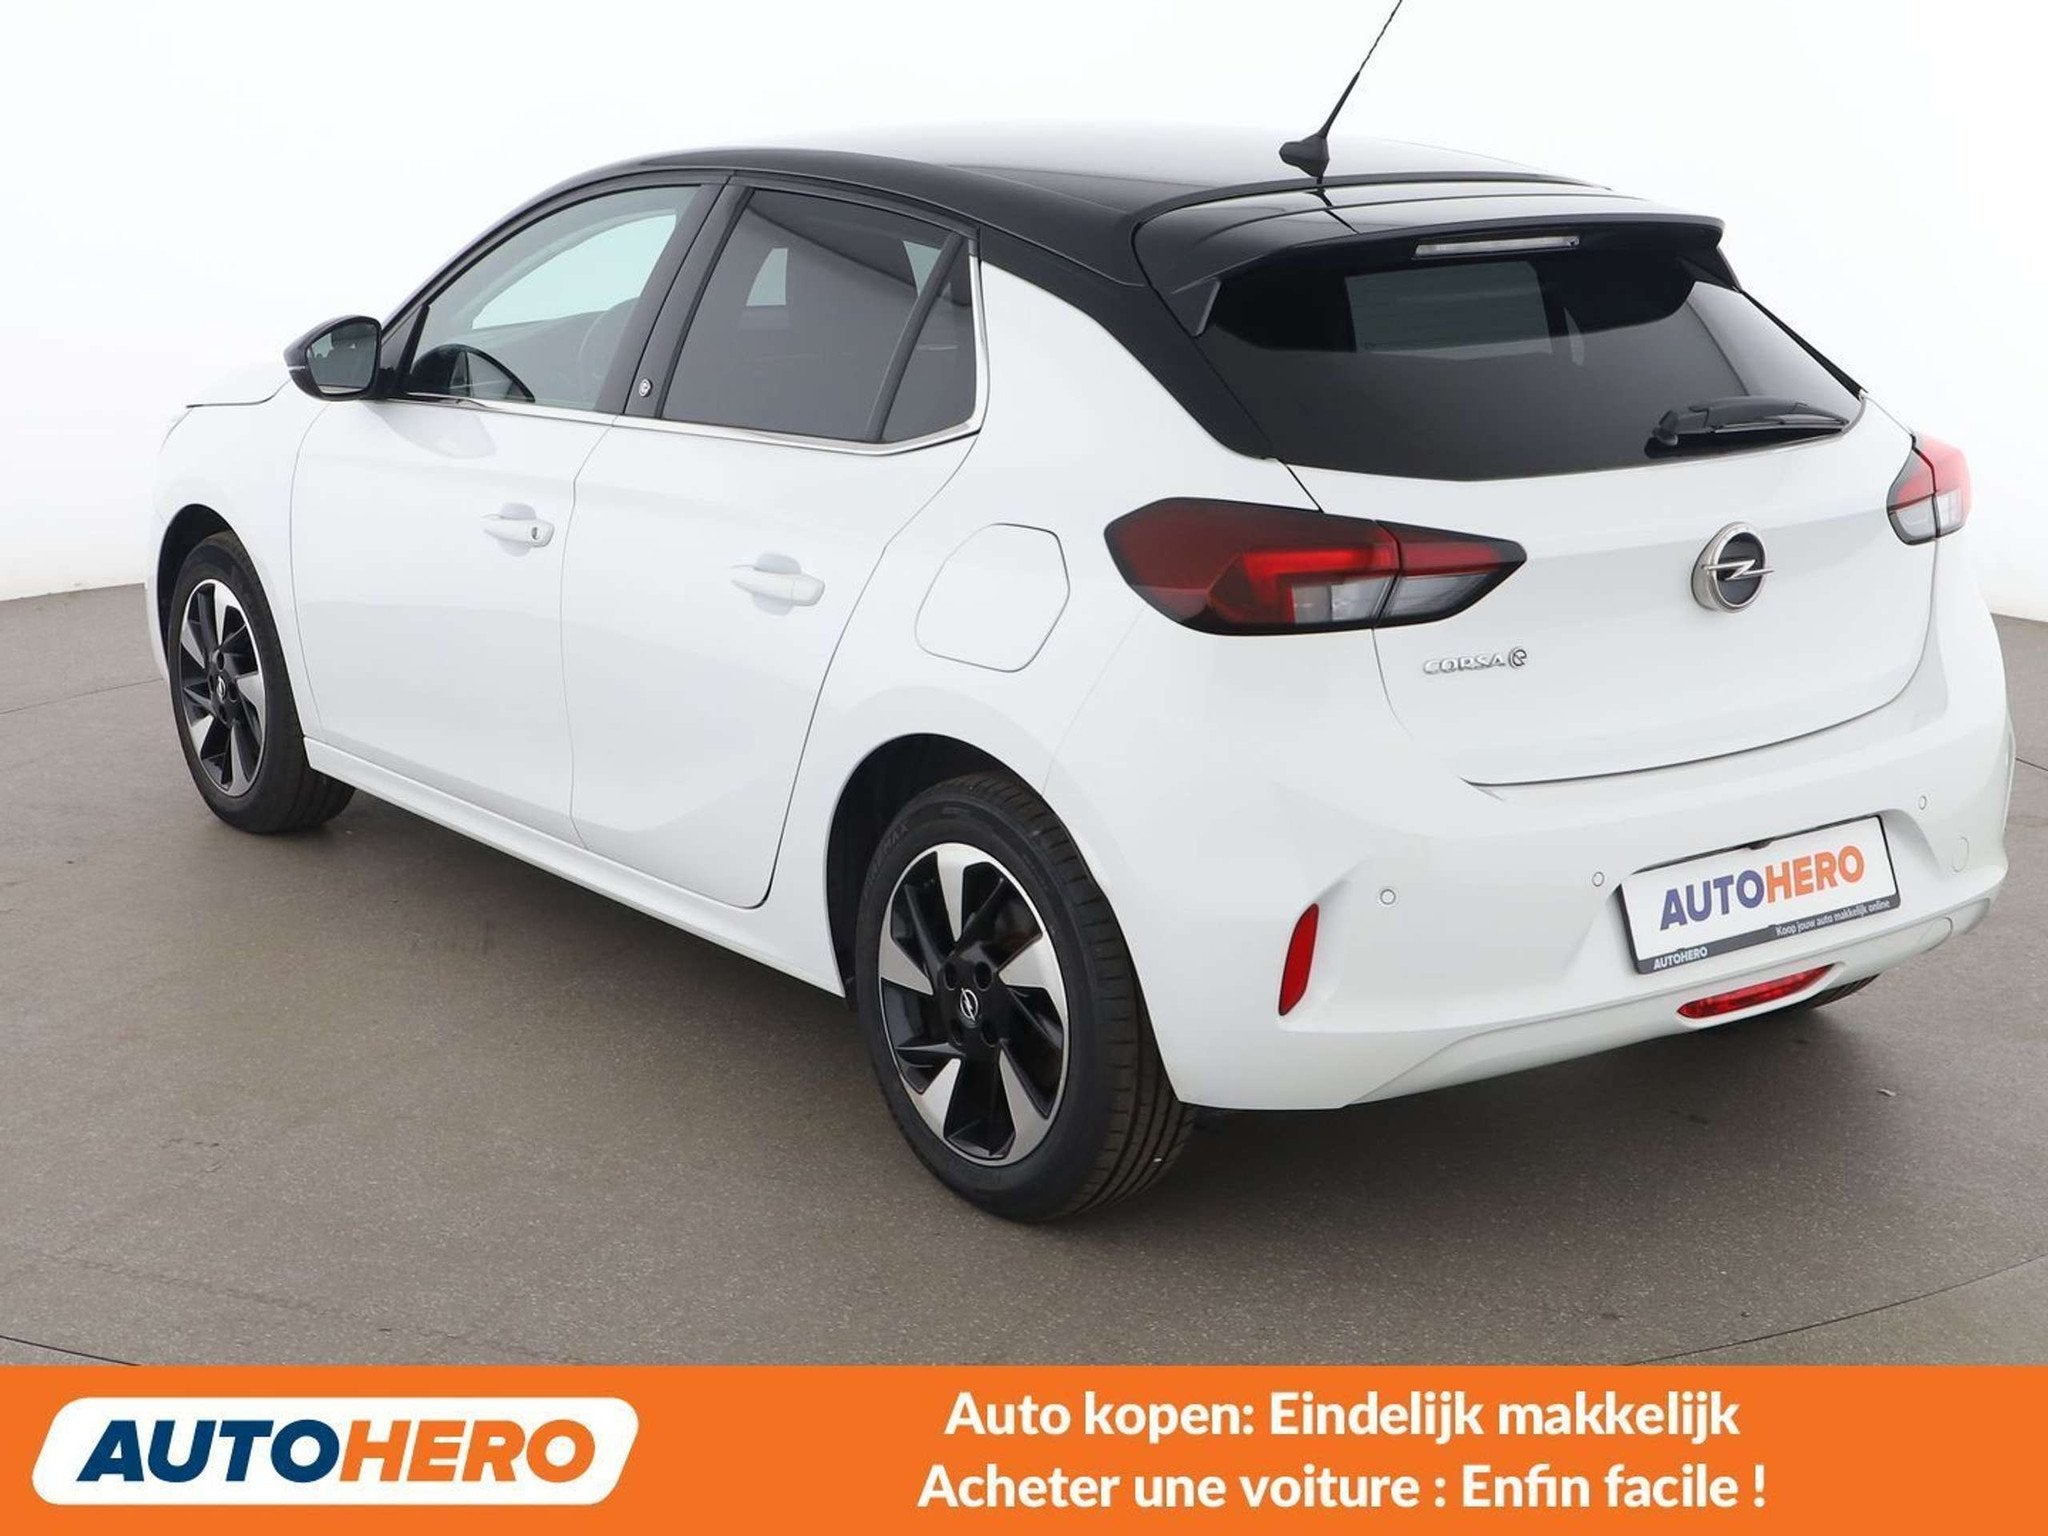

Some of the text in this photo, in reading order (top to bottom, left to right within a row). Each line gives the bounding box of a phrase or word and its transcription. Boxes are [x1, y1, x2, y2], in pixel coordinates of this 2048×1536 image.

[1423, 653, 1505, 675] CORSA
[1660, 845, 1865, 930] AUTOHERO
[1775, 899, 1890, 936] Koop jouw auto makkelijk online
[1653, 946, 1708, 970] AUTOHERO
